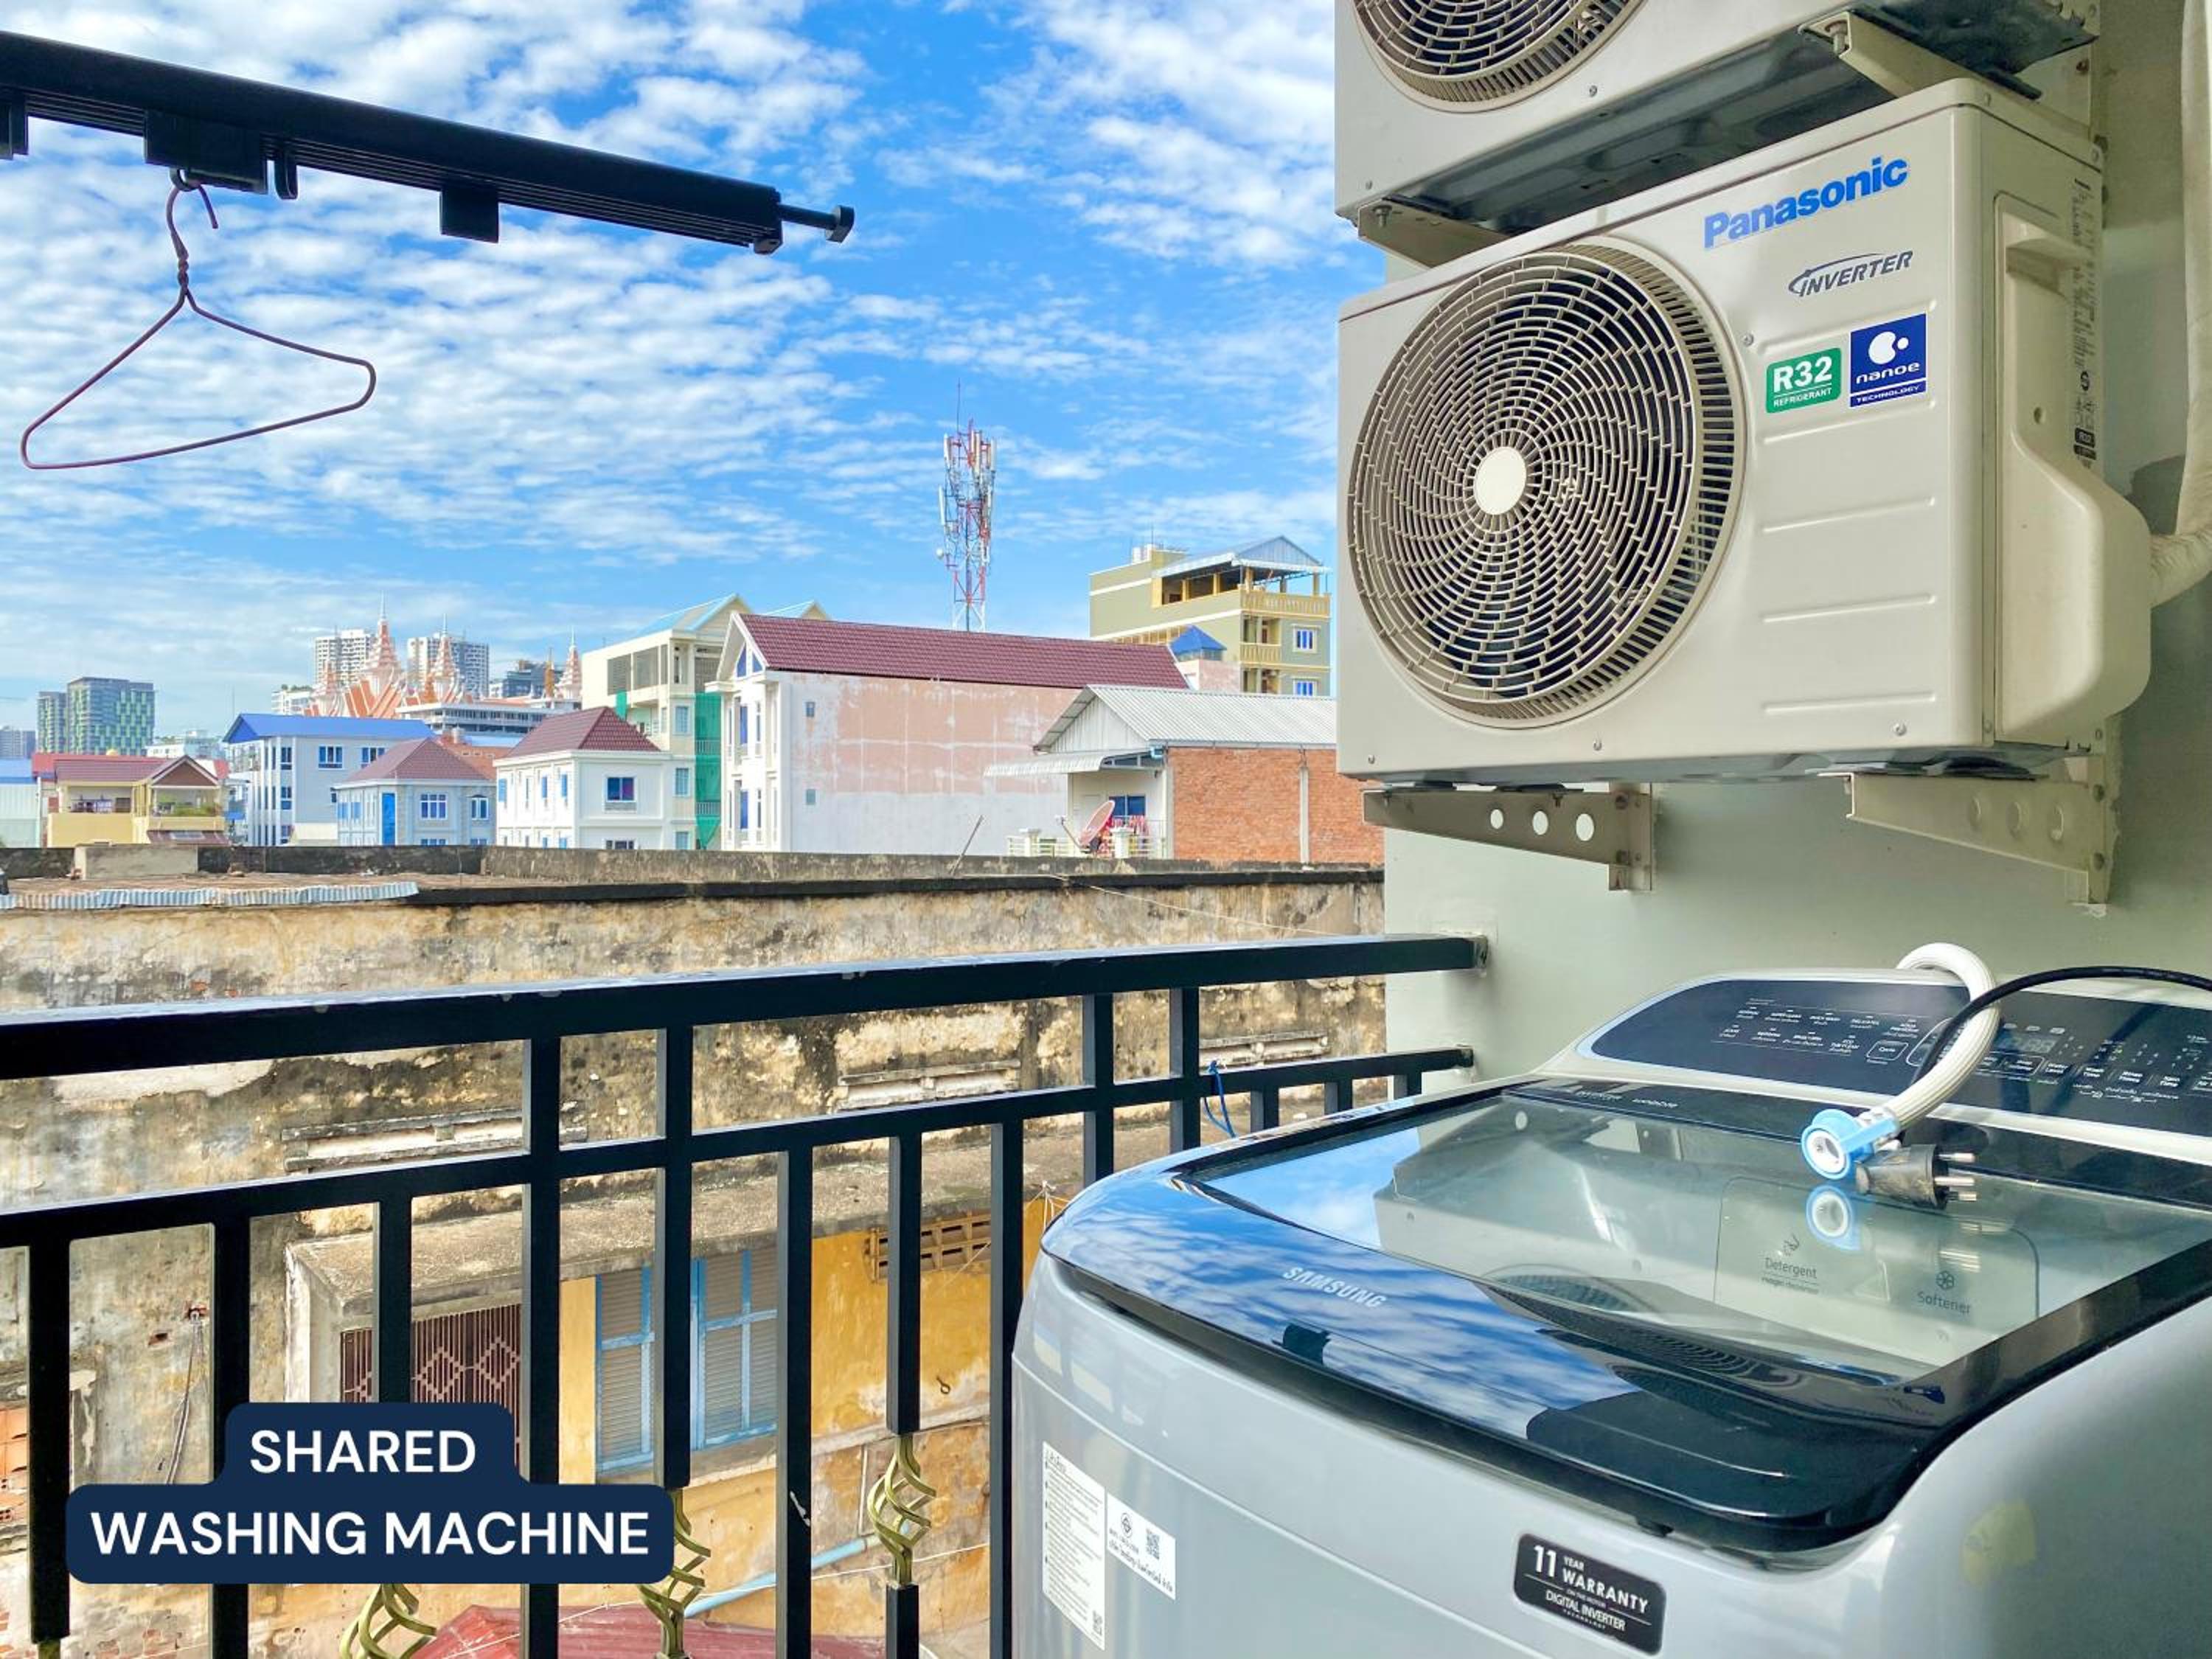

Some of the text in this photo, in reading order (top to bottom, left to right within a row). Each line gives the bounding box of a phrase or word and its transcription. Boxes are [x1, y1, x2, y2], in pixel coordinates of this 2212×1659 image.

[1704, 155, 1907, 248] Panasonic
[1798, 250, 1913, 296] INVERTER
[1773, 356, 1832, 393] R32
[1856, 362, 1920, 384] nanoe
[1773, 388, 1832, 407] REFRIGERANT
[1856, 385, 1920, 403] TECHNOLOGY
[1764, 1257, 1818, 1280] Detergent
[1284, 1267, 1386, 1307] SAMSUNG
[1917, 1291, 1971, 1315] Softener
[1534, 1545, 1585, 1577] 11 YEAR
[1562, 1568, 1648, 1614] WARRANTY
[1545, 1590, 1626, 1631] DIGITAL INVERTER
